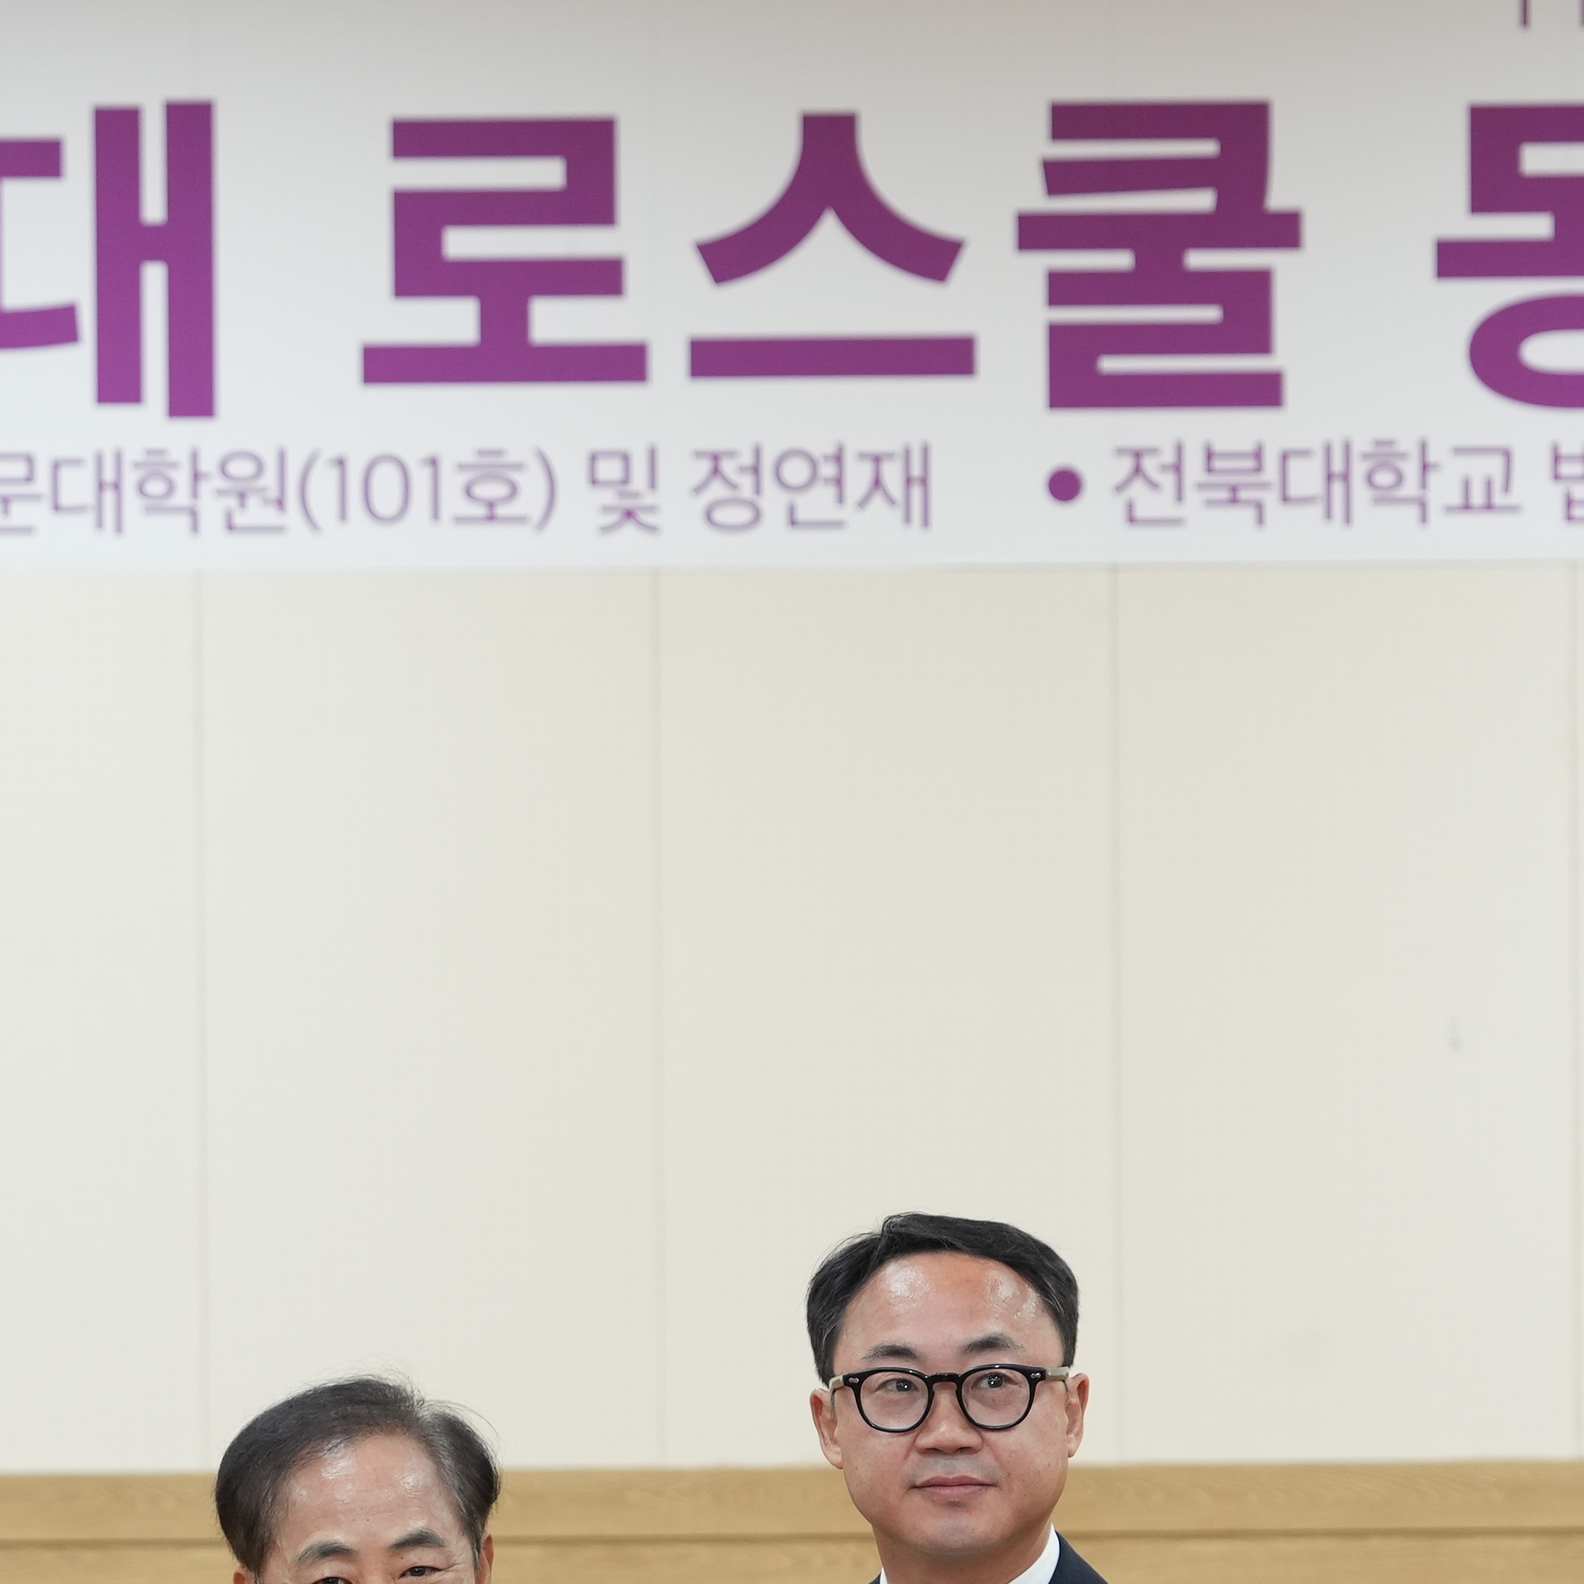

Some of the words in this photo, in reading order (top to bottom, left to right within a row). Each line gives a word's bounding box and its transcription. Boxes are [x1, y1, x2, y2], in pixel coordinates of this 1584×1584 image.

[357, 97, 1306, 414] 로스쿨
[586, 445, 661, 533] 및
[692, 443, 933, 531] 정연재
[1113, 439, 1522, 527] 전북대학교
